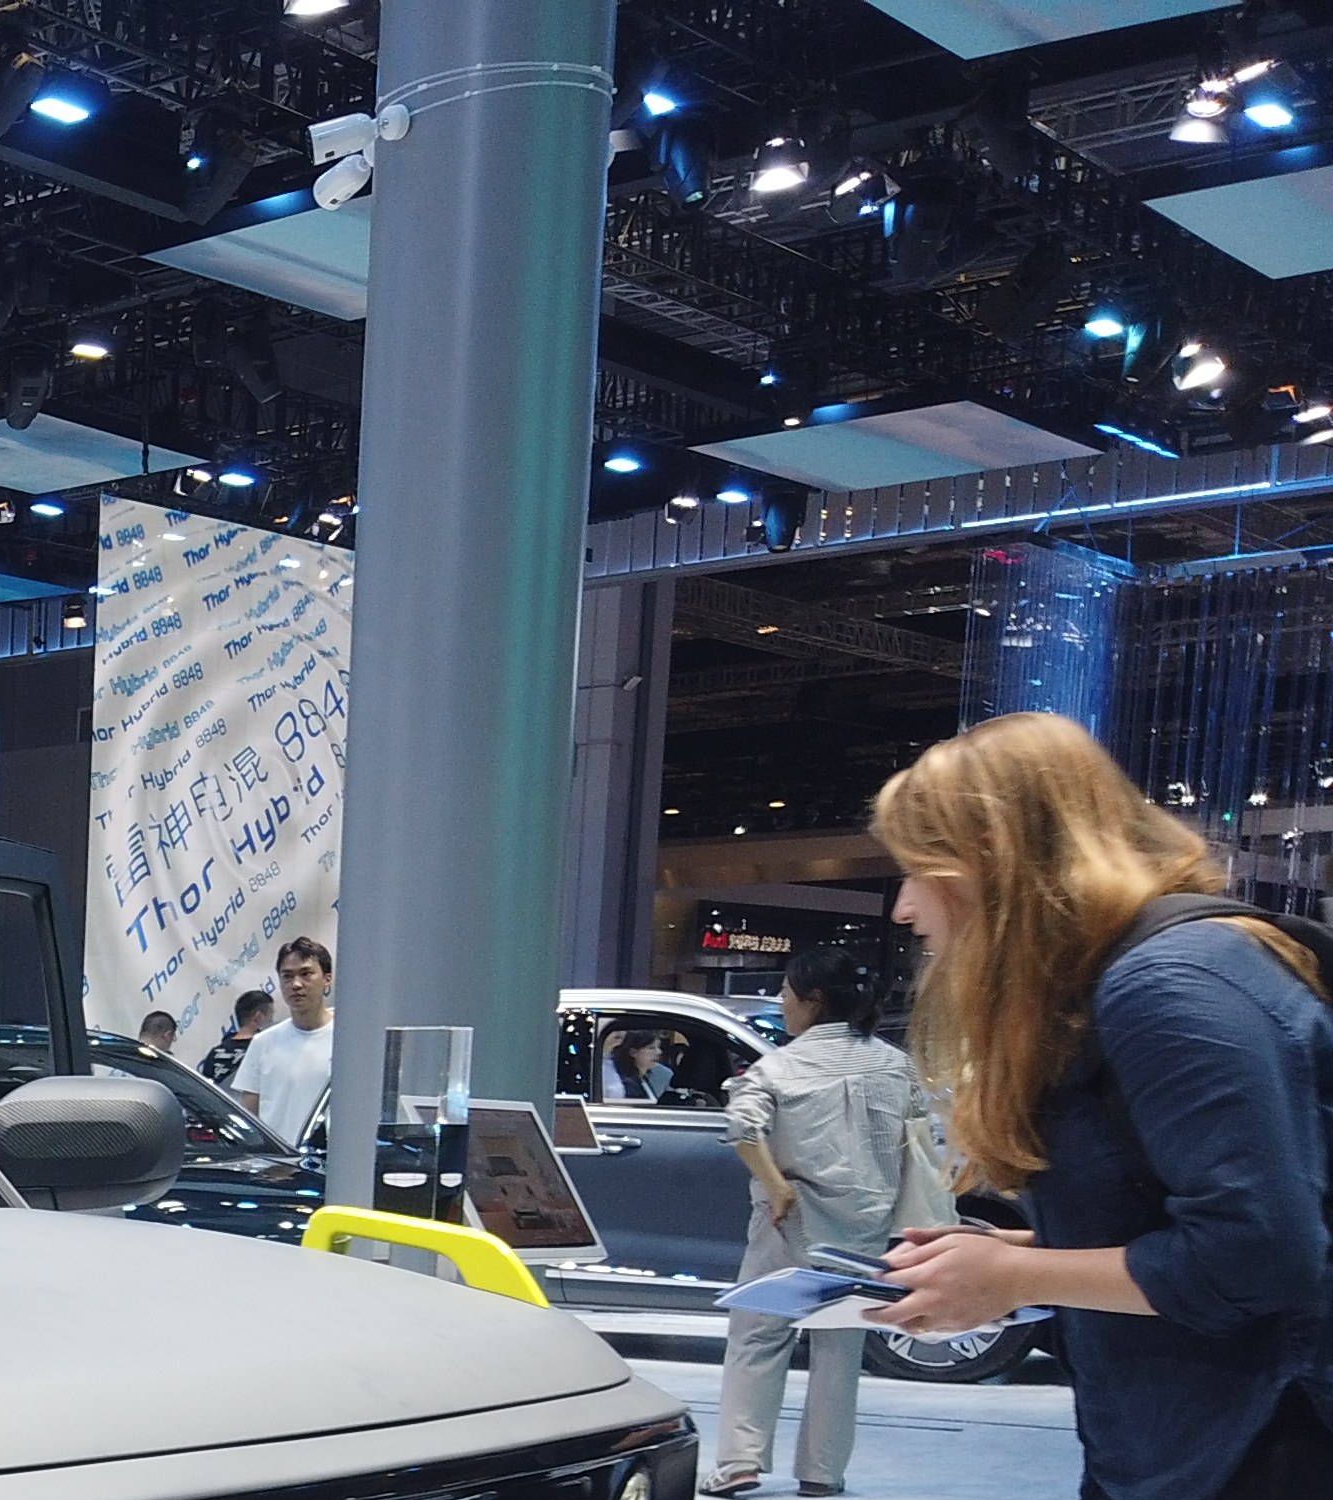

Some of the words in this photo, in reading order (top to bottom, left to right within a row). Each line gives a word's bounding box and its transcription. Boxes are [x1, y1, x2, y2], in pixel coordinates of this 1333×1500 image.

[116, 524, 145, 547] 8848
[183, 543, 211, 568] Thor
[133, 566, 163, 590] 8848
[202, 585, 231, 612] Thor
[151, 611, 182, 638] 8848
[224, 632, 253, 659] Thor
[121, 683, 169, 732] Hybrid
[173, 662, 204, 689] 8848
[247, 685, 277, 712] Thor
[280, 654, 317, 690] Hybrid
[275, 670, 349, 763] 884
[141, 750, 191, 791] Hybrid
[196, 718, 227, 748] 8848
[301, 804, 332, 844] Thor
[126, 857, 214, 953] Thor
[262, 891, 297, 940] 8848
[141, 948, 185, 1002] Thor
[192, 887, 246, 951] Hybrid
[249, 861, 281, 893] 8848
